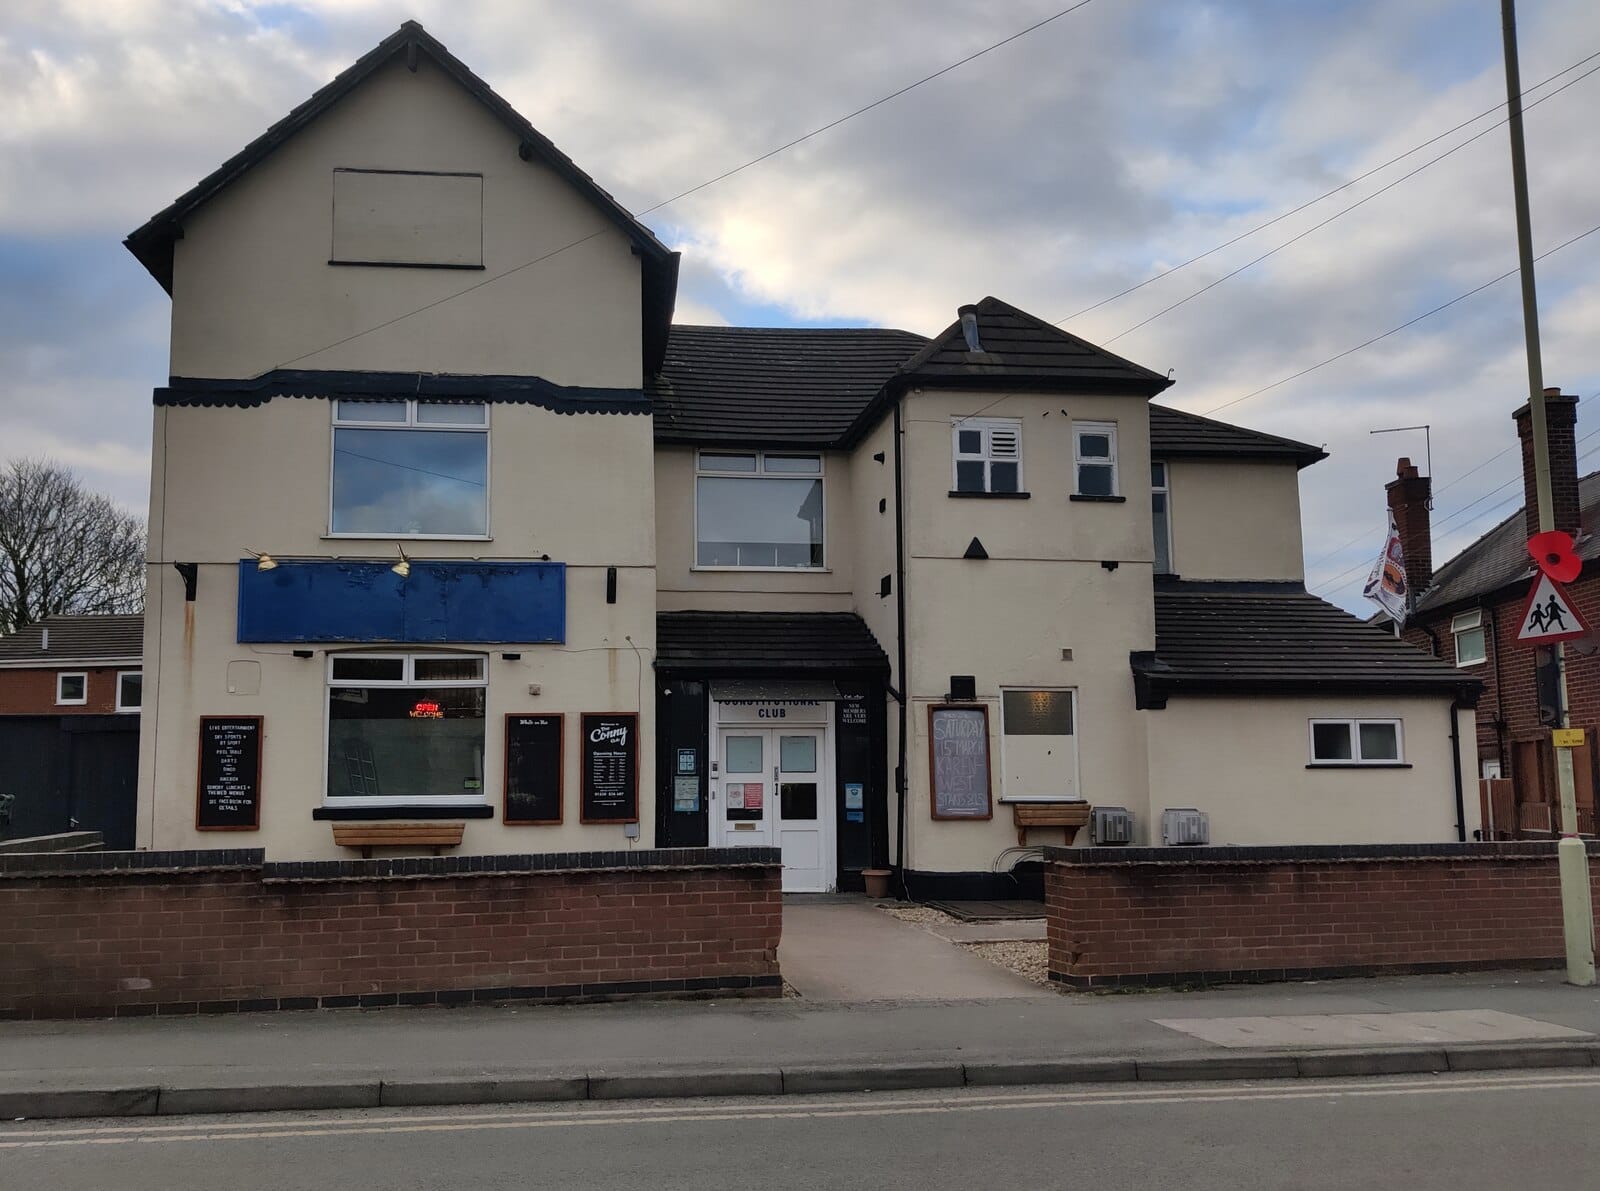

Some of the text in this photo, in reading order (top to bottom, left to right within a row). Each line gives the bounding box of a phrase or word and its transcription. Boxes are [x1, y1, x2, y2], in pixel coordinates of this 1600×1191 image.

[758, 708, 786, 718] CLUB
[590, 727, 627, 746] Conny
[934, 718, 985, 740] SATURDAY
